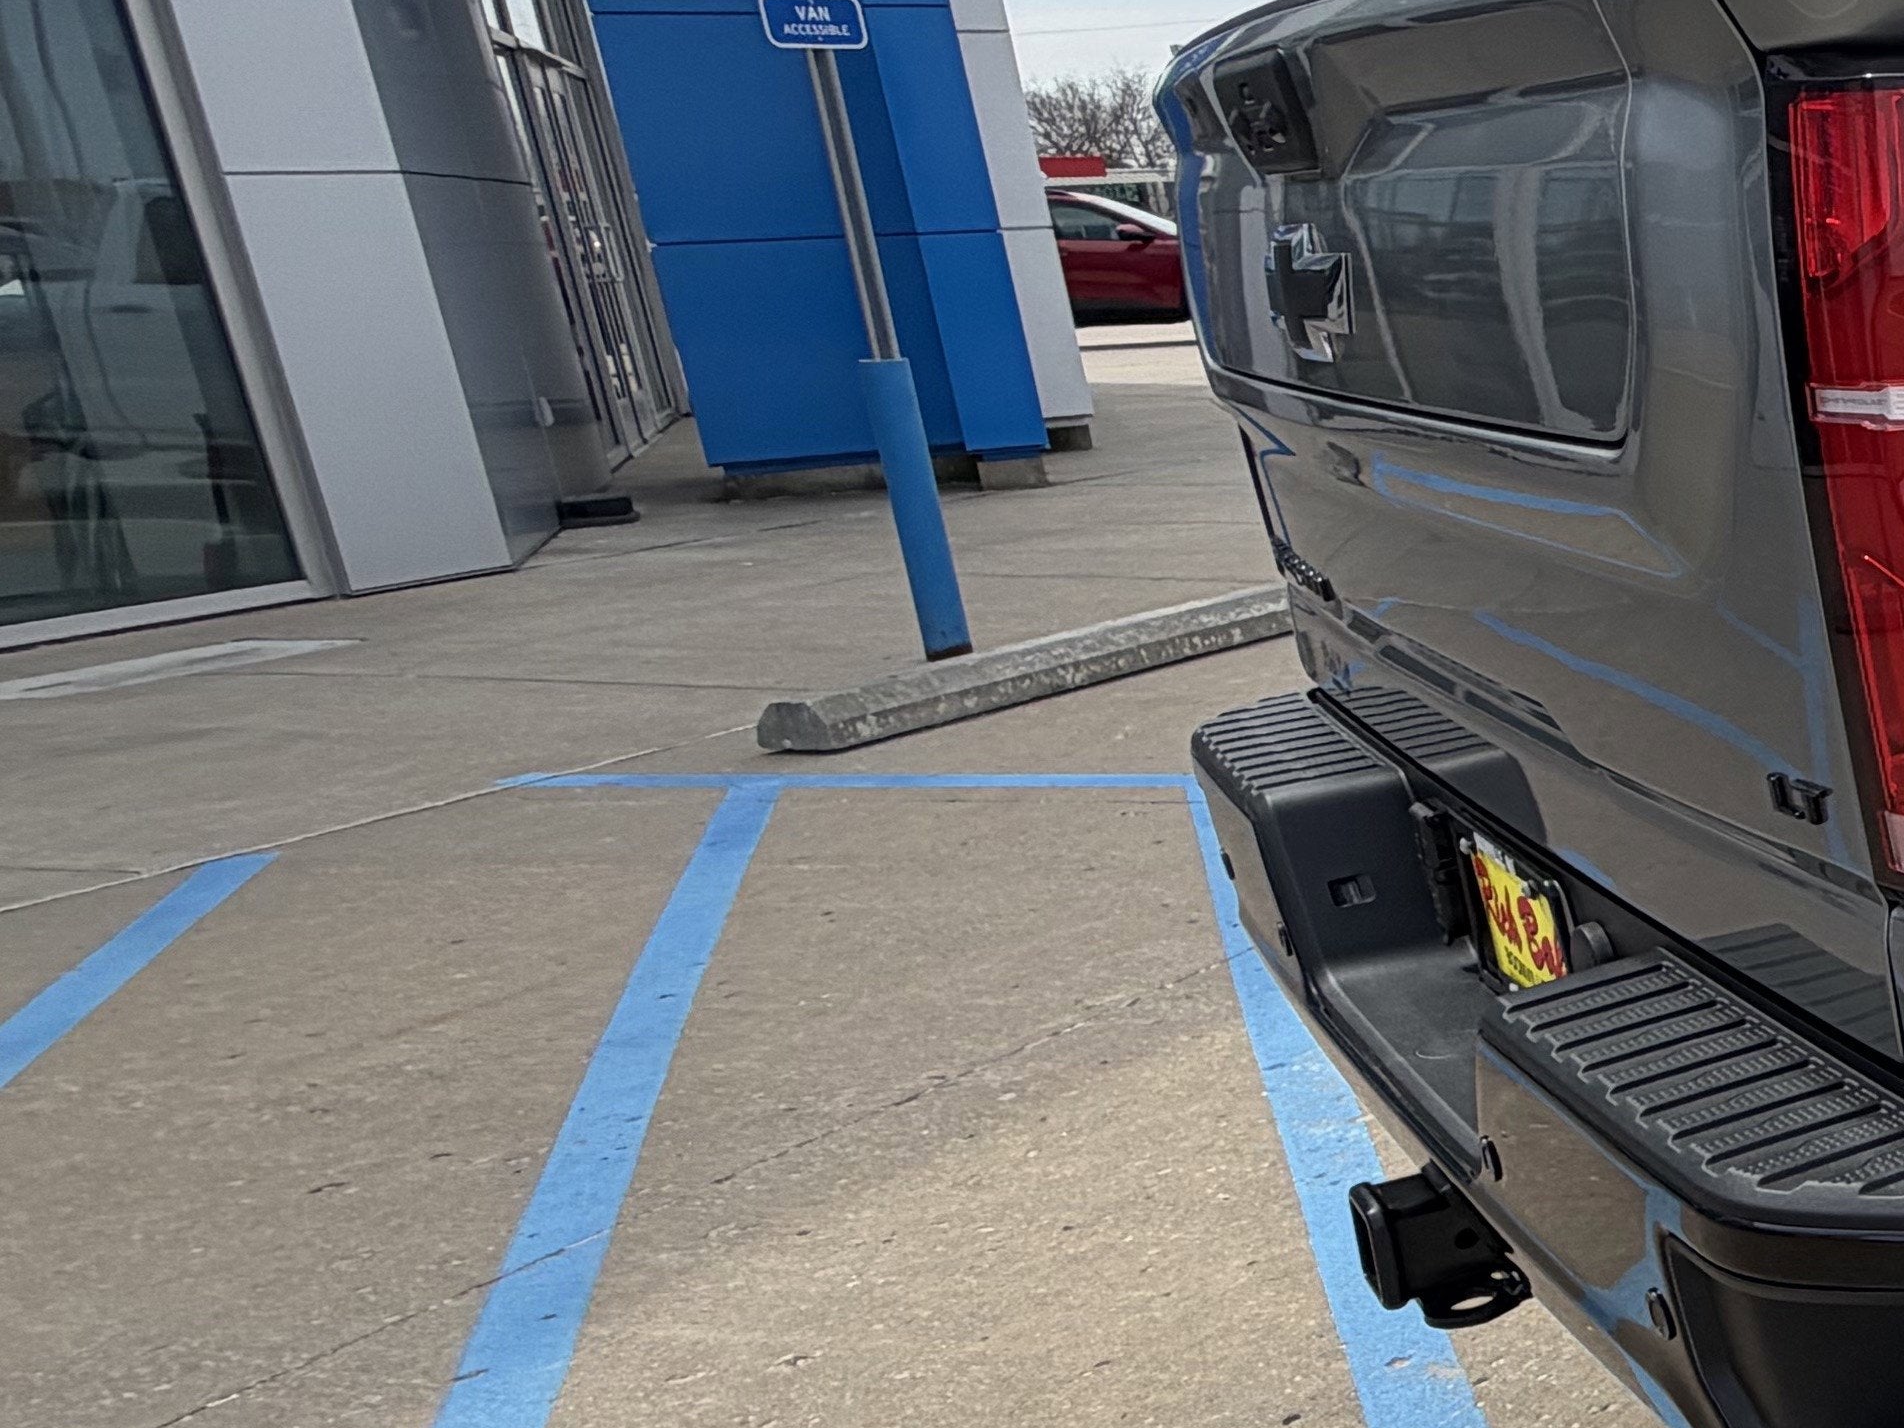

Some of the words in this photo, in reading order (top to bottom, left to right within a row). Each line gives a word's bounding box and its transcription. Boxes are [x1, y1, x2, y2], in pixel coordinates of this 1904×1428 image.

[794, 5, 831, 22] VAN
[783, 23, 851, 36] ACCESSIBLE
[1766, 772, 1833, 825] LT
